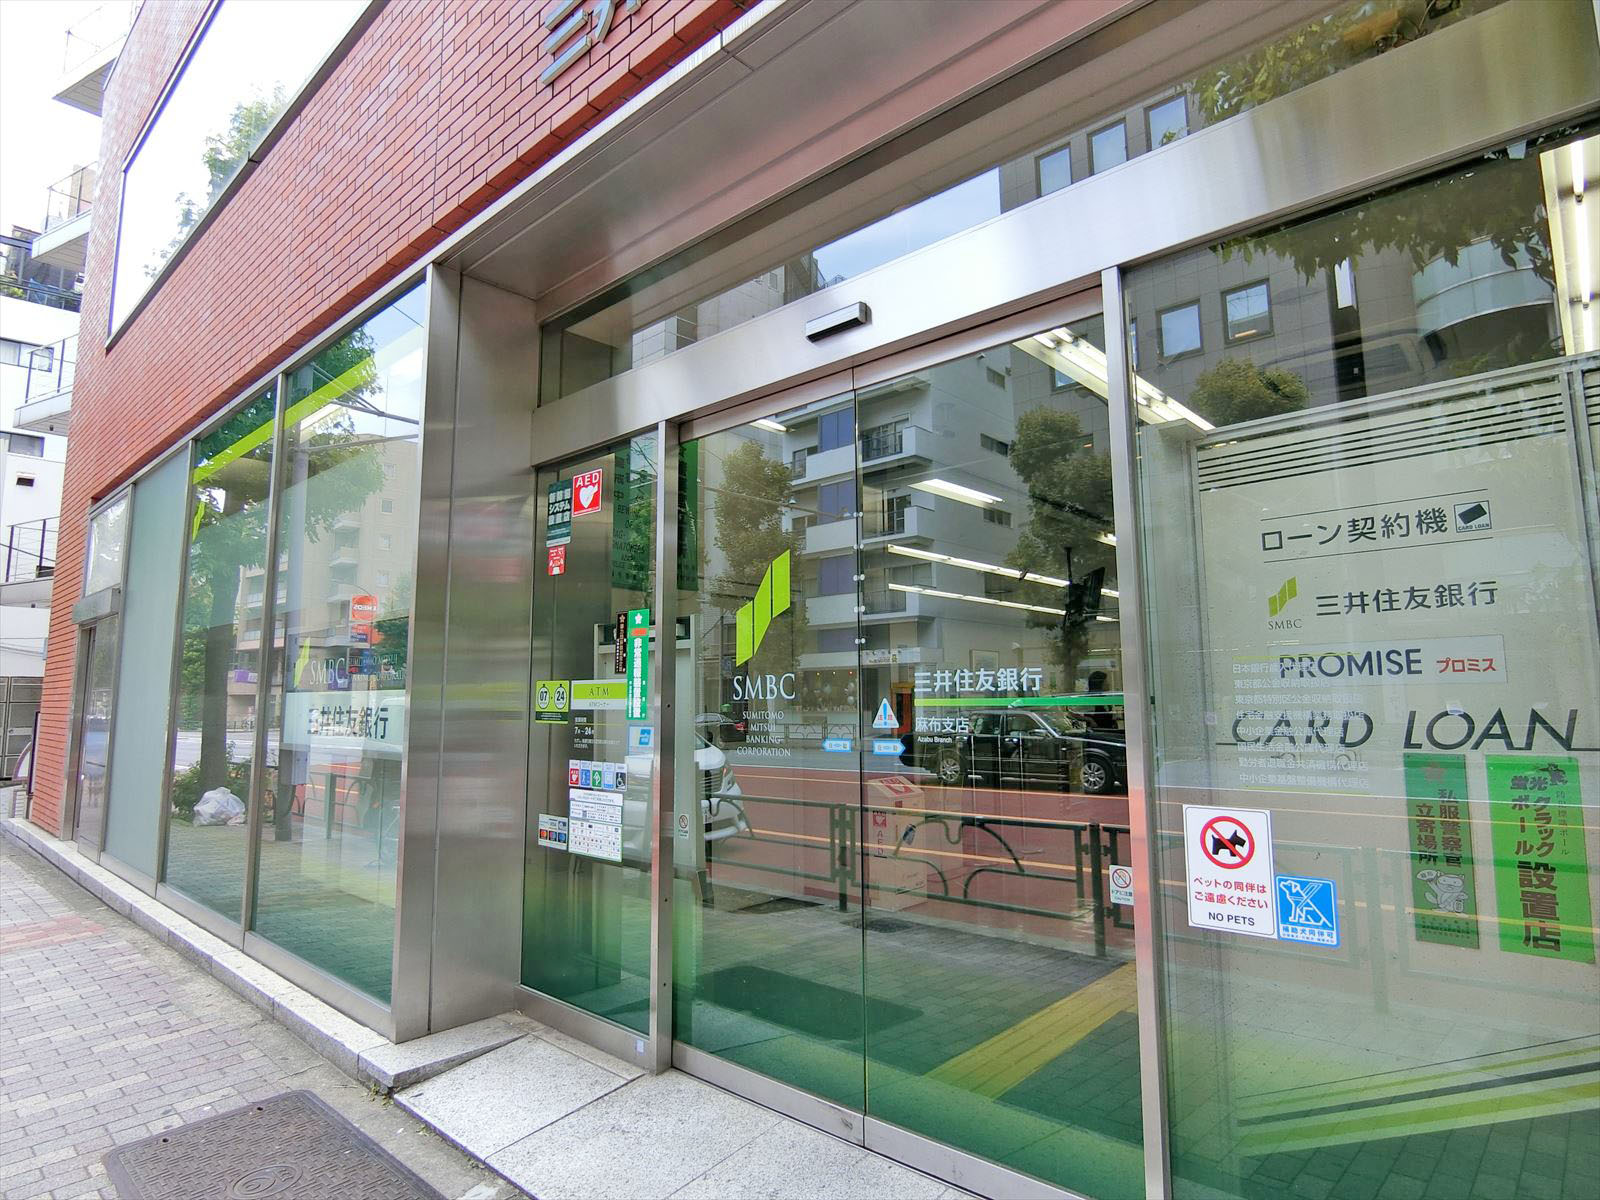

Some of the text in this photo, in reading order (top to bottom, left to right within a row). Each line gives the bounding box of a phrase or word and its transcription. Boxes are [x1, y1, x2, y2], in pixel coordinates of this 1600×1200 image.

[576, 472, 600, 488] AED
[548, 500, 571, 515] システム
[1261, 507, 1448, 552] ローン契約機
[1316, 580, 1498, 617] 三井住友銀行
[1268, 619, 1303, 631] SMBC
[310, 657, 347, 686] SMBC
[1279, 648, 1423, 678] PROMISE
[1436, 657, 1497, 674] プロミス
[732, 673, 796, 701] SMBC
[914, 667, 1043, 692] 三井住友銀行
[539, 690, 565, 701] 07 24
[588, 687, 609, 697] ATM
[307, 705, 389, 740] 三井住友銀行
[742, 710, 785, 720] SUMITOMO
[750, 722, 776, 732] MITSUI
[915, 716, 970, 734] 麻布支店
[1232, 707, 1579, 751] CARD LOAN
[745, 735, 780, 744] BANKING
[933, 736, 953, 744] Branch
[736, 747, 791, 757] CORPORATION
[1415, 803, 1439, 866] 立寄場所
[1510, 795, 1534, 856] ボール
[1193, 876, 1267, 894] ペットの同伴は
[1194, 890, 1269, 909] ご遠慮ください
[1516, 860, 1562, 952] 設置店
[1208, 912, 1255, 926] NO PETS
